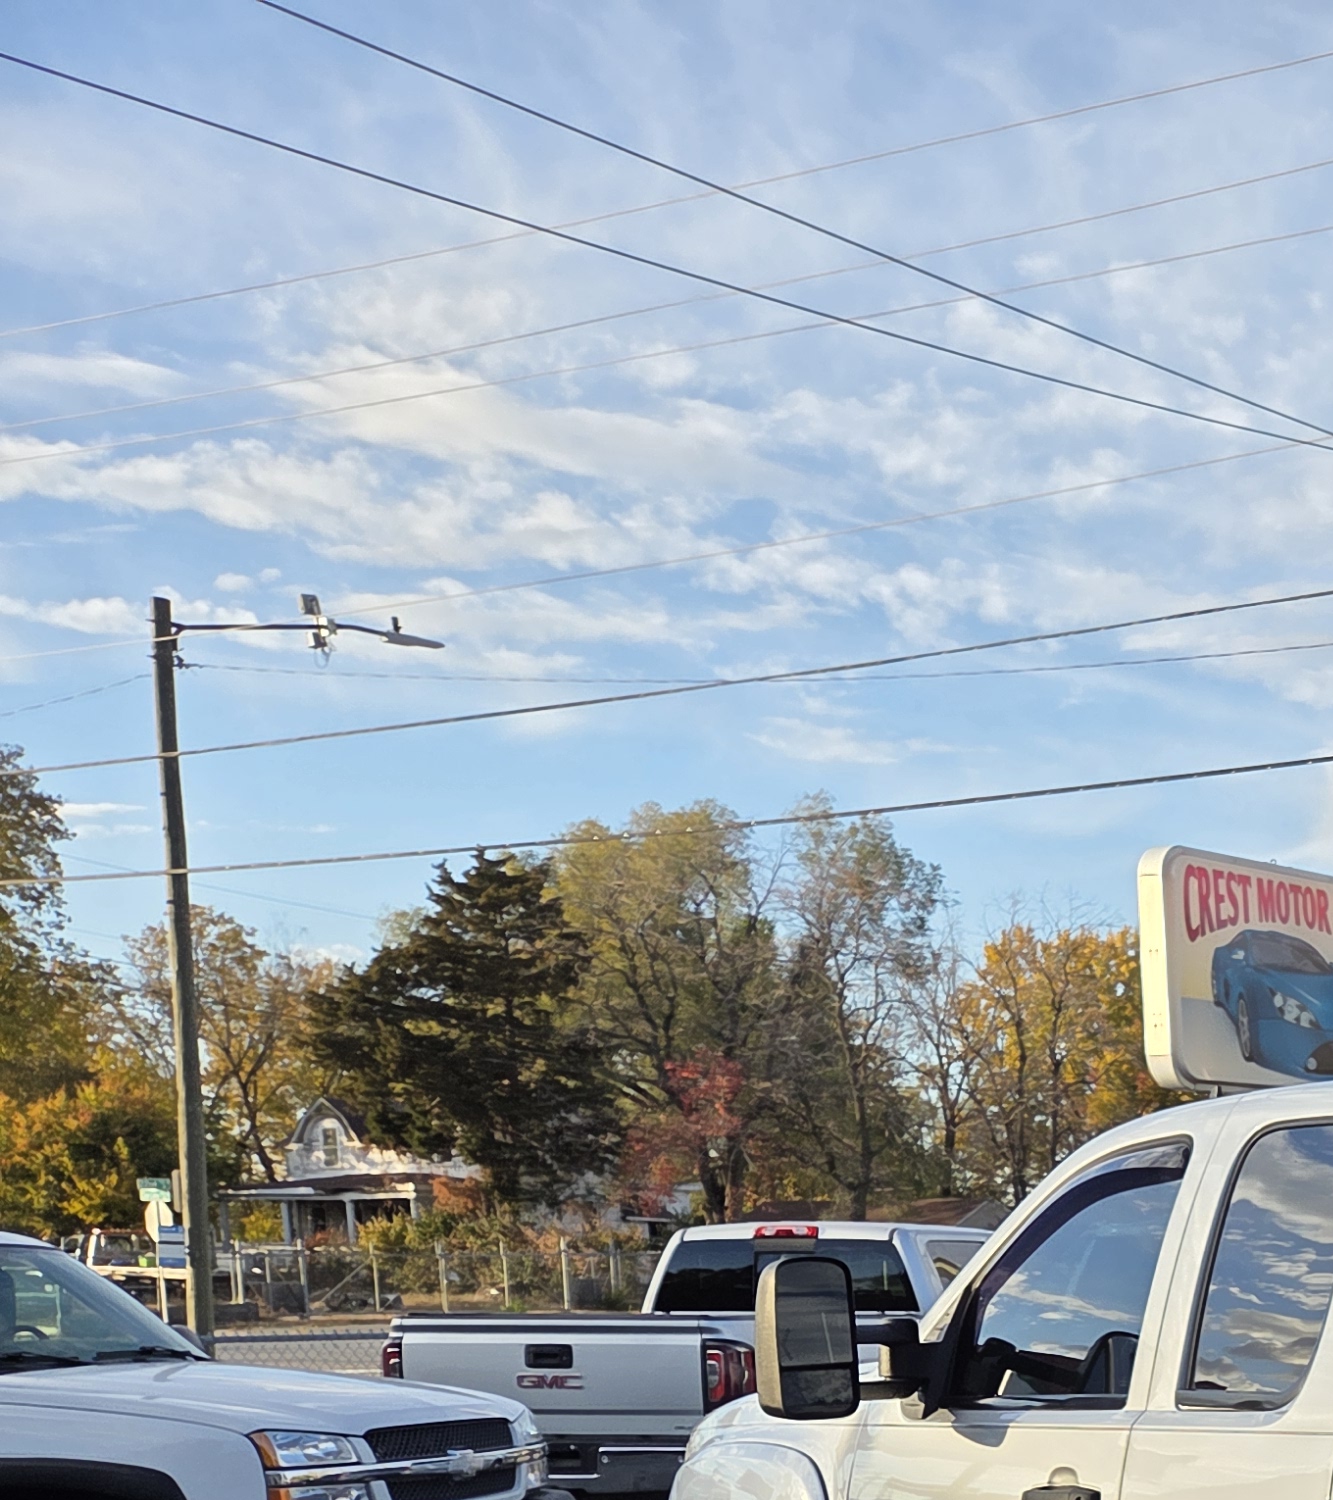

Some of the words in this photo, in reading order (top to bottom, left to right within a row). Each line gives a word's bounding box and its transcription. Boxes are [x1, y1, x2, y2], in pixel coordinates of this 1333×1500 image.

[1183, 864, 1251, 942] CREST
[1257, 878, 1332, 935] MOTOR
[516, 1374, 584, 1389] GMC
